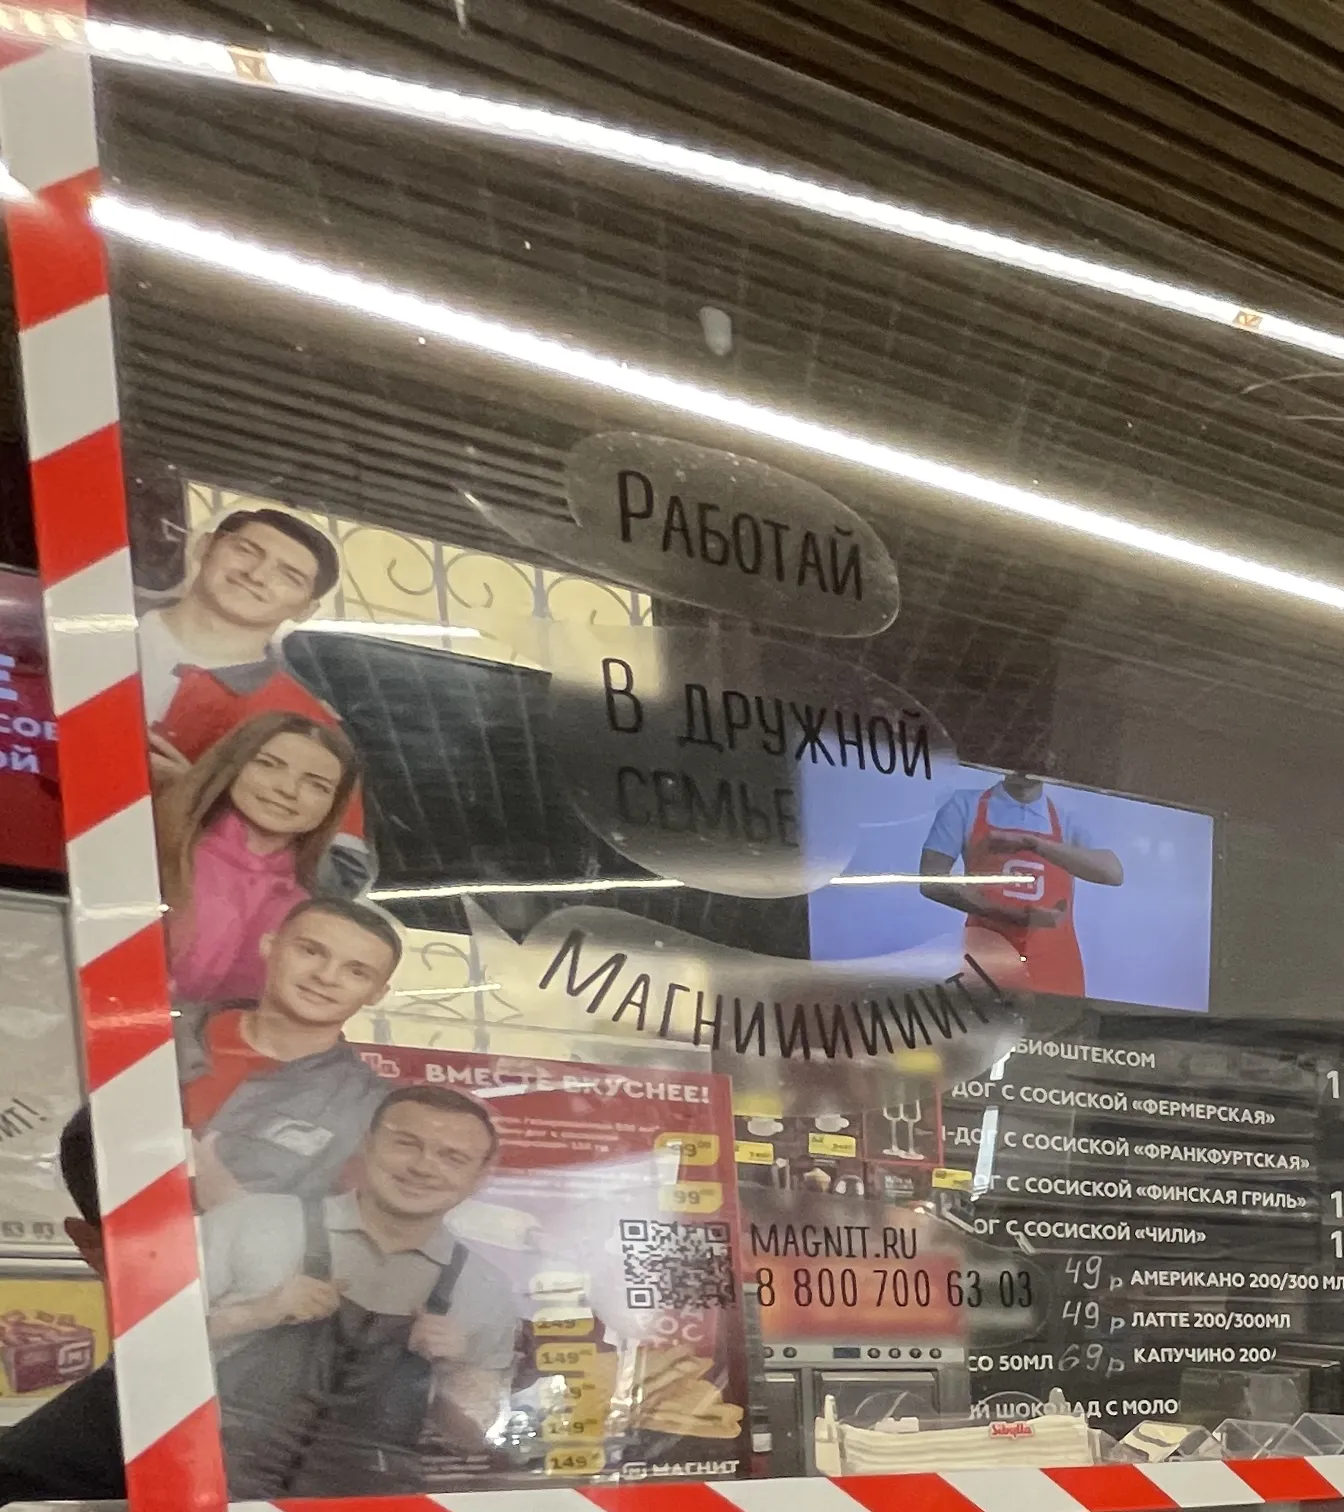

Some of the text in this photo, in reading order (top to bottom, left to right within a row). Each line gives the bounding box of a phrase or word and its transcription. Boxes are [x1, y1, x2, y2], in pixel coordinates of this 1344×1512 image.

[617, 470, 865, 600] РАБОТАЙ
[601, 657, 932, 780] В ДРУЖНОЙ
[616, 766, 799, 848] СЕМЬЕ
[1001, 1083, 1015, 1098] С
[1019, 1086, 1128, 1112] СОСИСКОЙ
[1132, 1099, 1276, 1125] «ФЕРМЕРСКАЯ»
[1003, 1131, 1018, 1147] С
[1021, 1132, 1130, 1157] СОСИСКОЙ
[1133, 1141, 1311, 1170] «ФРАНКФУРТСКАЯ»
[1006, 1175, 1307, 1210] С СОСИСКОЙ «ФИНСКАЯ ГРИЛЬ»
[750, 1223, 918, 1260] MAGNIT.RU
[1023, 1219, 1131, 1243] СОСИСКОЙ
[1135, 1226, 1207, 1245] «ЧИЛИ»
[756, 1267, 1033, 1308] 8 800 700 63 03
[1130, 1269, 1246, 1290] АМЕРИКАНО
[1249, 1272, 1319, 1292] 200/300
[1131, 1311, 1190, 1328] ЛАТТЕ
[999, 1354, 1053, 1372] 50МЛ
[1133, 1347, 1236, 1364] КАПУЧИНО
[1105, 1401, 1118, 1416] С
[1122, 1399, 1180, 1416] МОЛО
